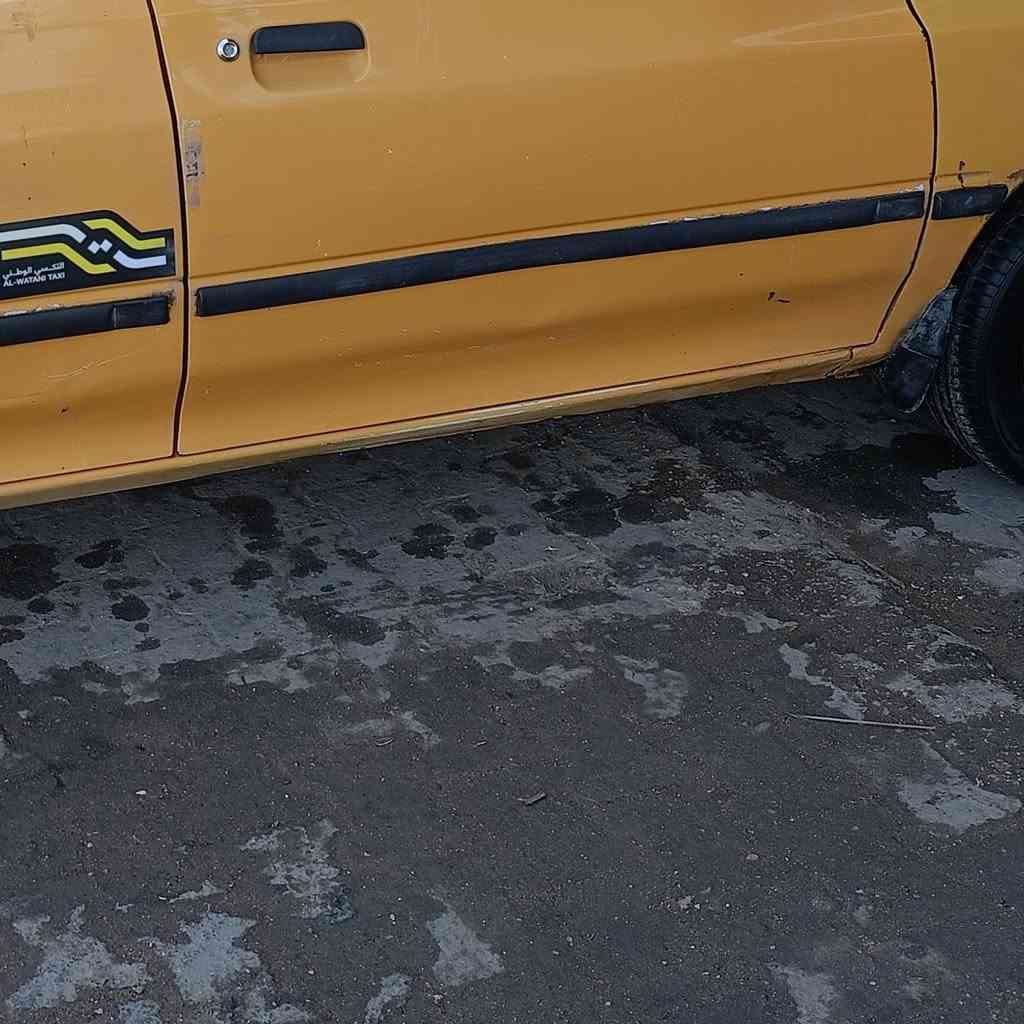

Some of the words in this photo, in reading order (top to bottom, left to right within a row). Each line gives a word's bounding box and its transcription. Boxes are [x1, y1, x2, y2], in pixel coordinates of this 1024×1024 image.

[2, 266, 33, 280] الوطني
[34, 261, 65, 276] التكسي
[3, 275, 47, 287] AL-WATANI
[47, 271, 66, 281] TAXI
